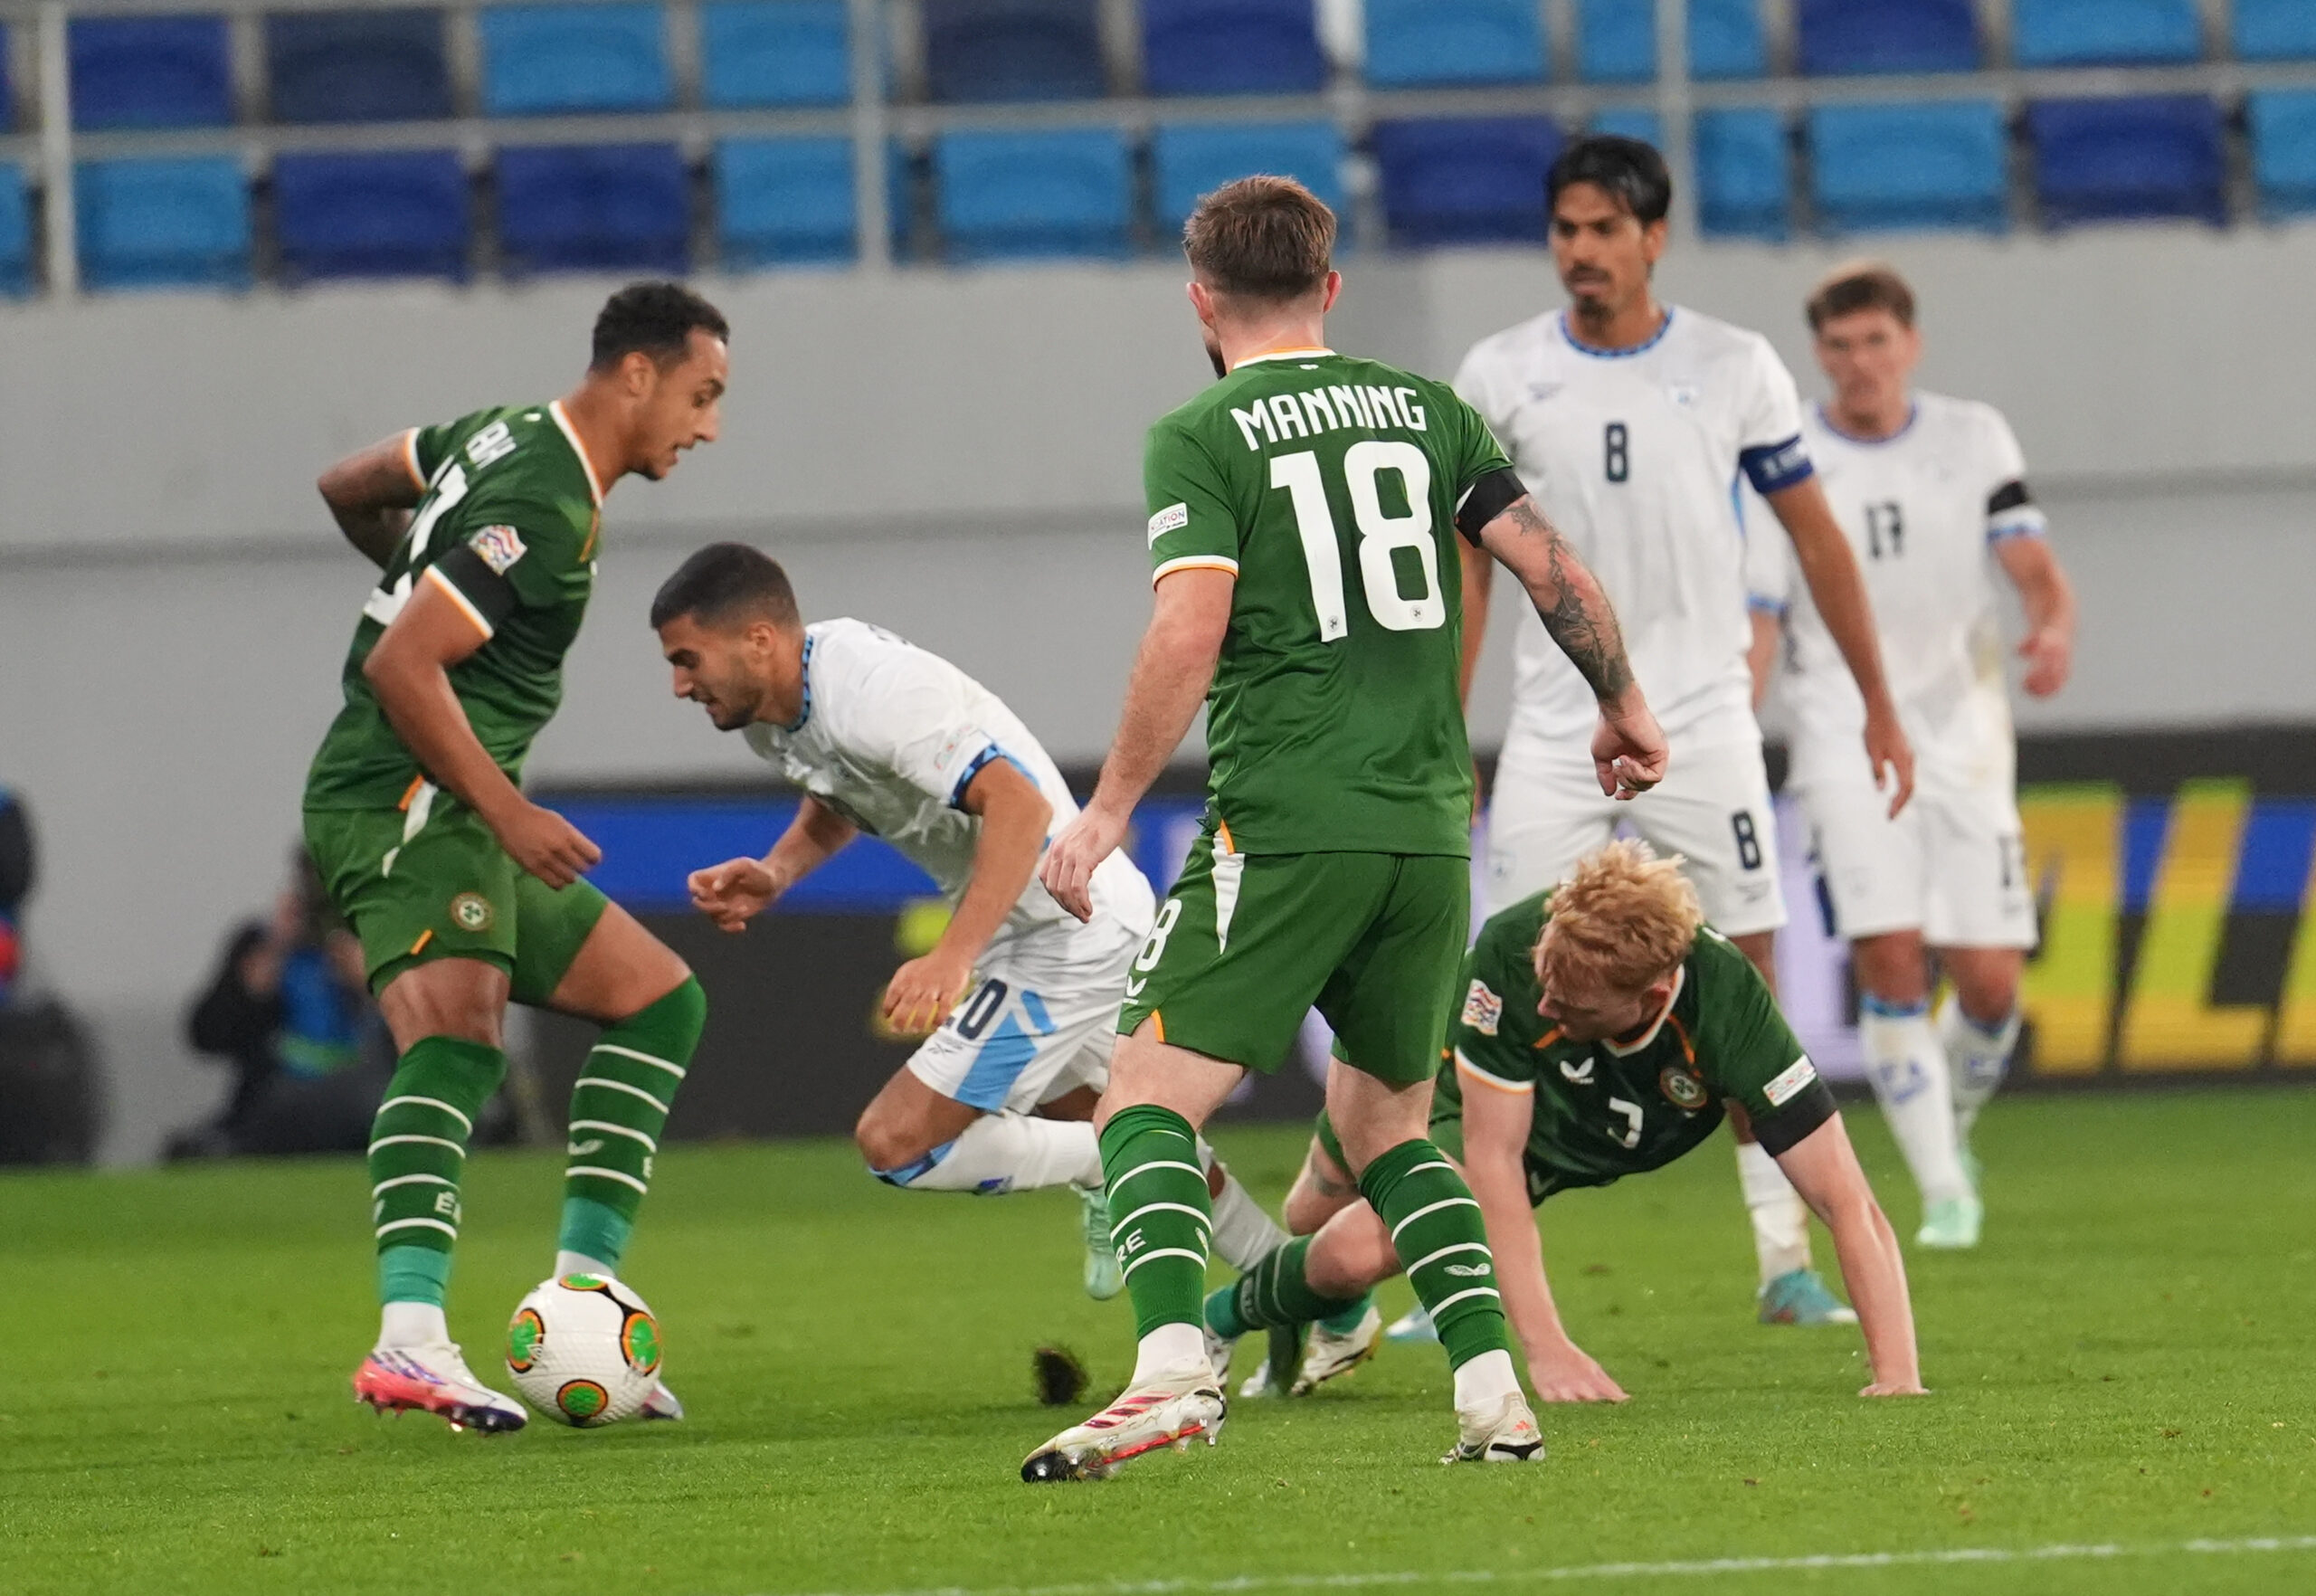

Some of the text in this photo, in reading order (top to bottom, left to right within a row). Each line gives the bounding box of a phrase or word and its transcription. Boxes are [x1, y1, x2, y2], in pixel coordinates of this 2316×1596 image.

[1230, 385, 1428, 451] MANNING
[1605, 422, 1628, 483] 8
[1269, 441, 1446, 642] 18
[1732, 810, 1761, 869] 8
[1135, 898, 1182, 972] 8
[945, 978, 1008, 1041] 0
[1115, 1228, 1147, 1267] RE
